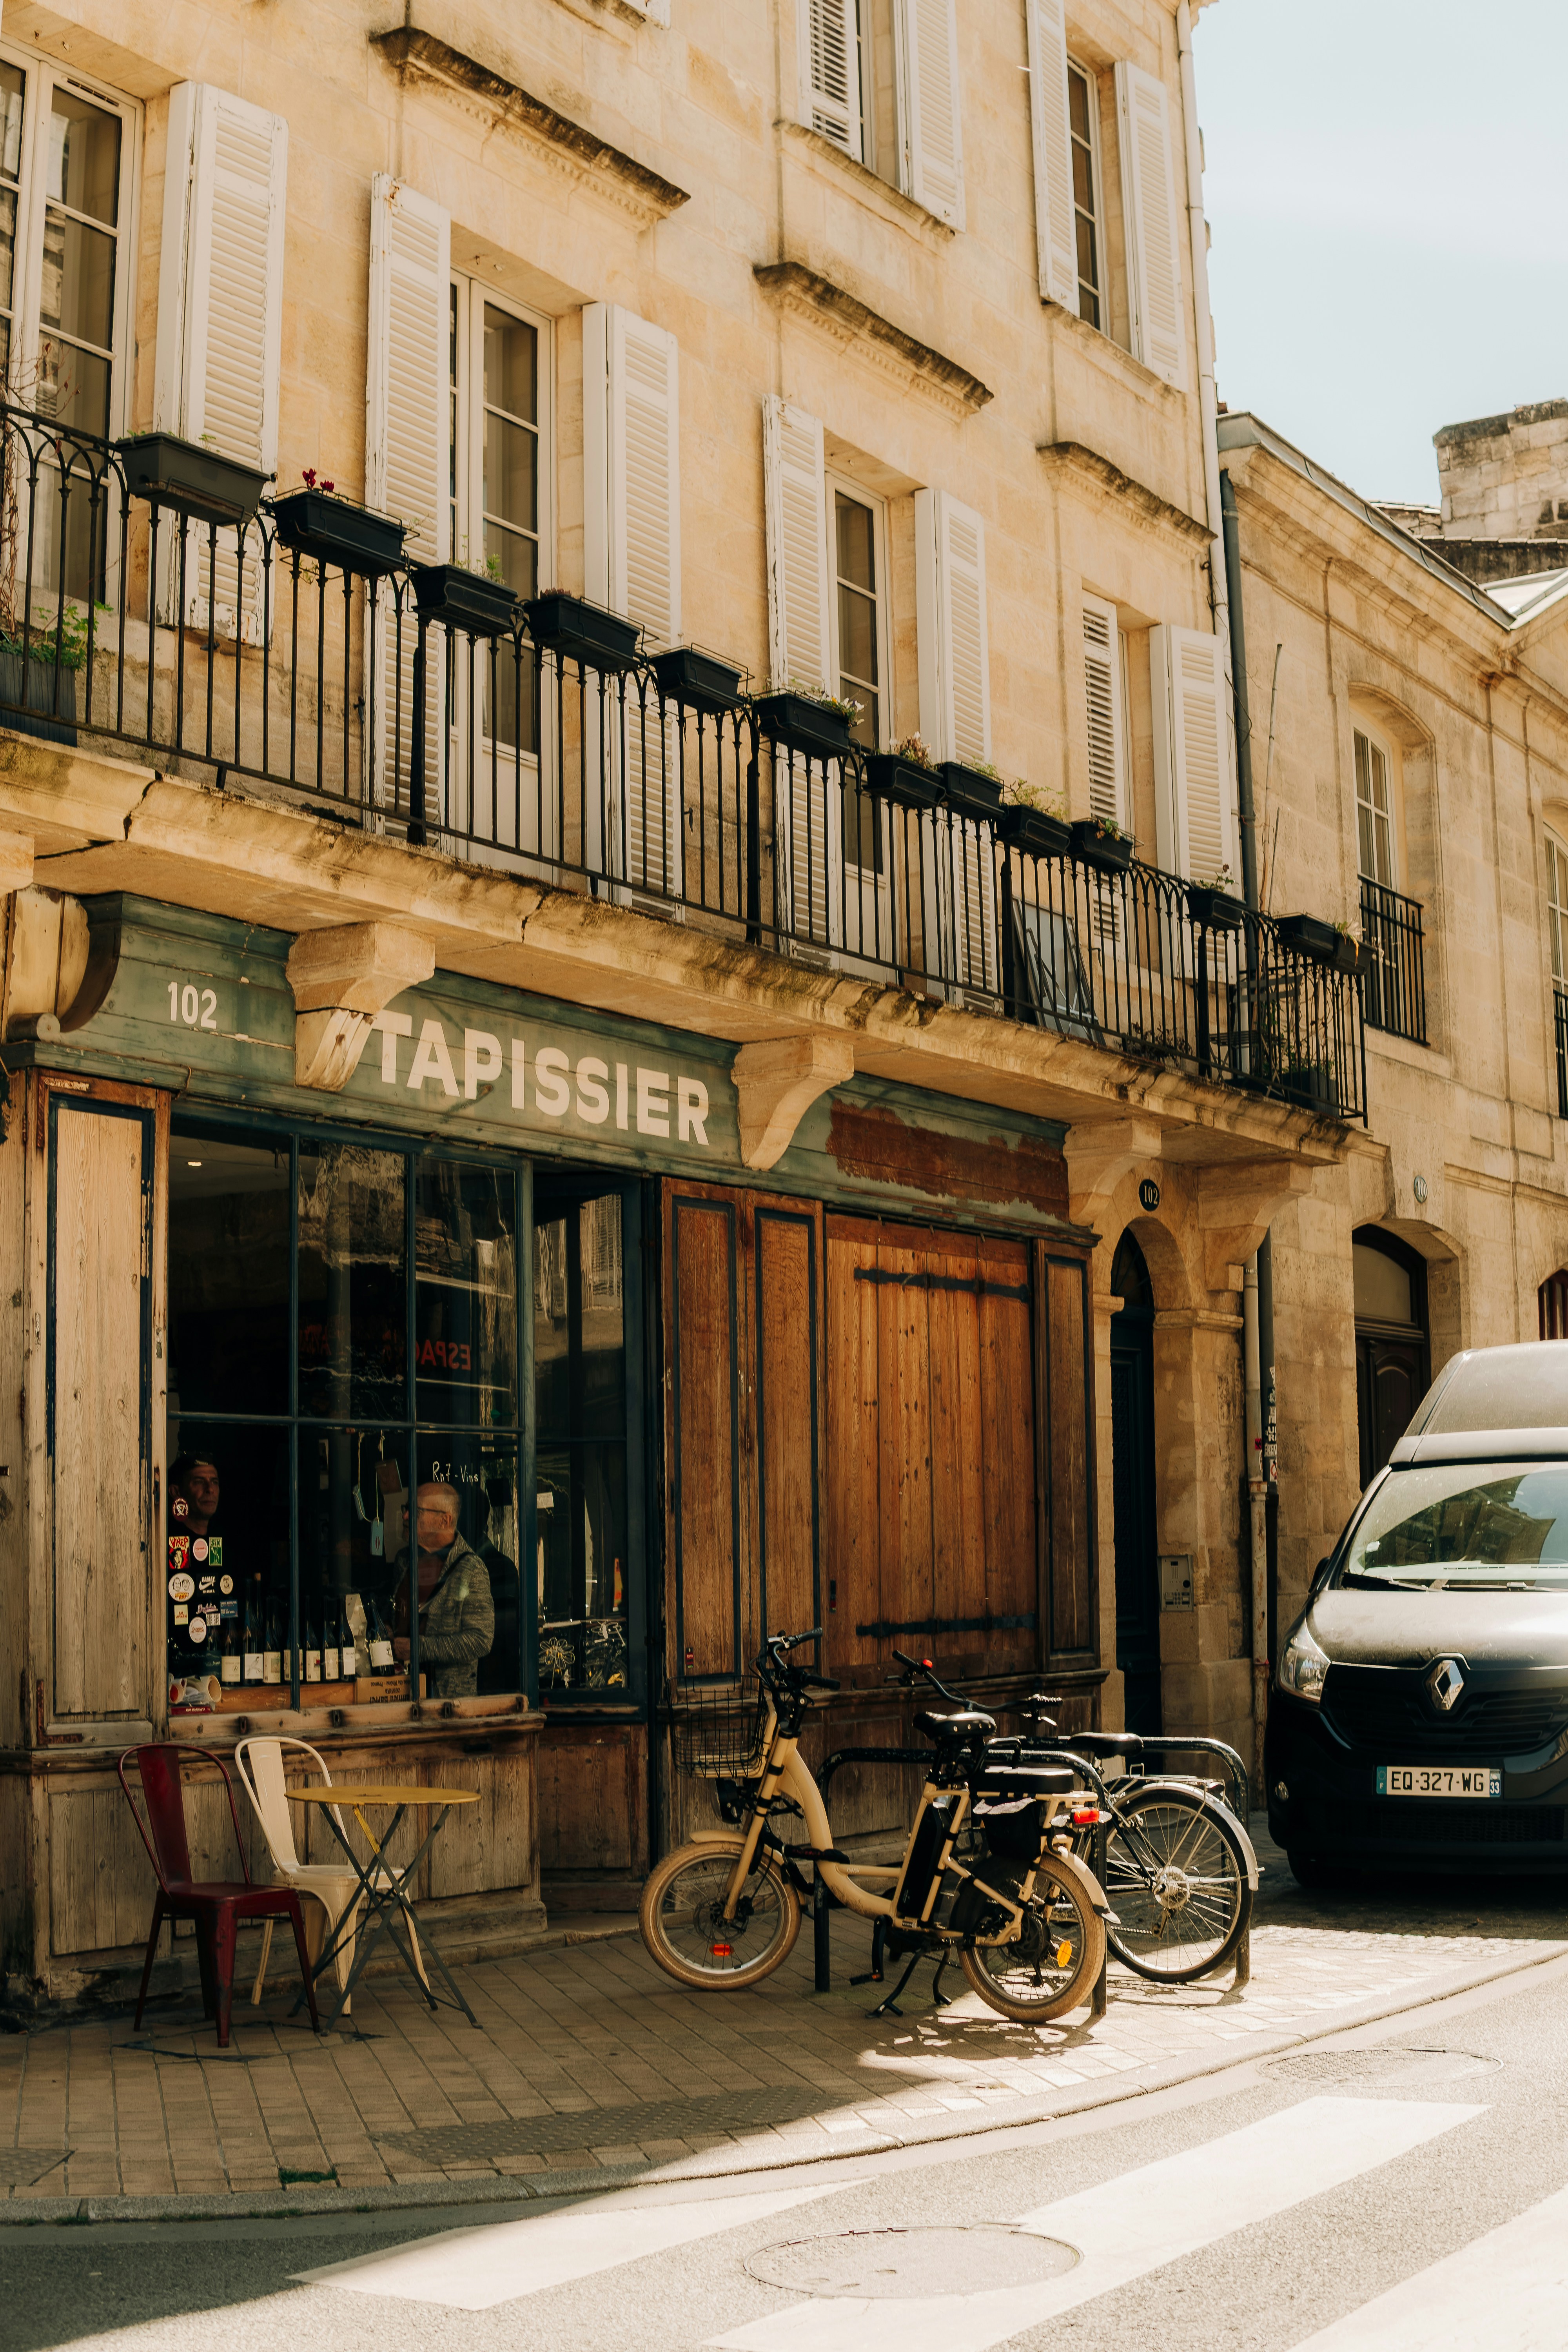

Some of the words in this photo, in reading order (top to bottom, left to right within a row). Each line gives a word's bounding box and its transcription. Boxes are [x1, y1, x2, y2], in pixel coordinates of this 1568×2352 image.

[167, 981, 218, 1029] 102
[371, 1009, 709, 1146] TAPISSIER
[1144, 1185, 1158, 1205] 102
[1417, 1181, 1427, 1198] 100
[433, 1461, 450, 1482] Rn7
[460, 1464, 478, 1483] Vins
[1391, 1771, 1484, 1792] EQ-327-WG
[1490, 1781, 1500, 1794] 33
